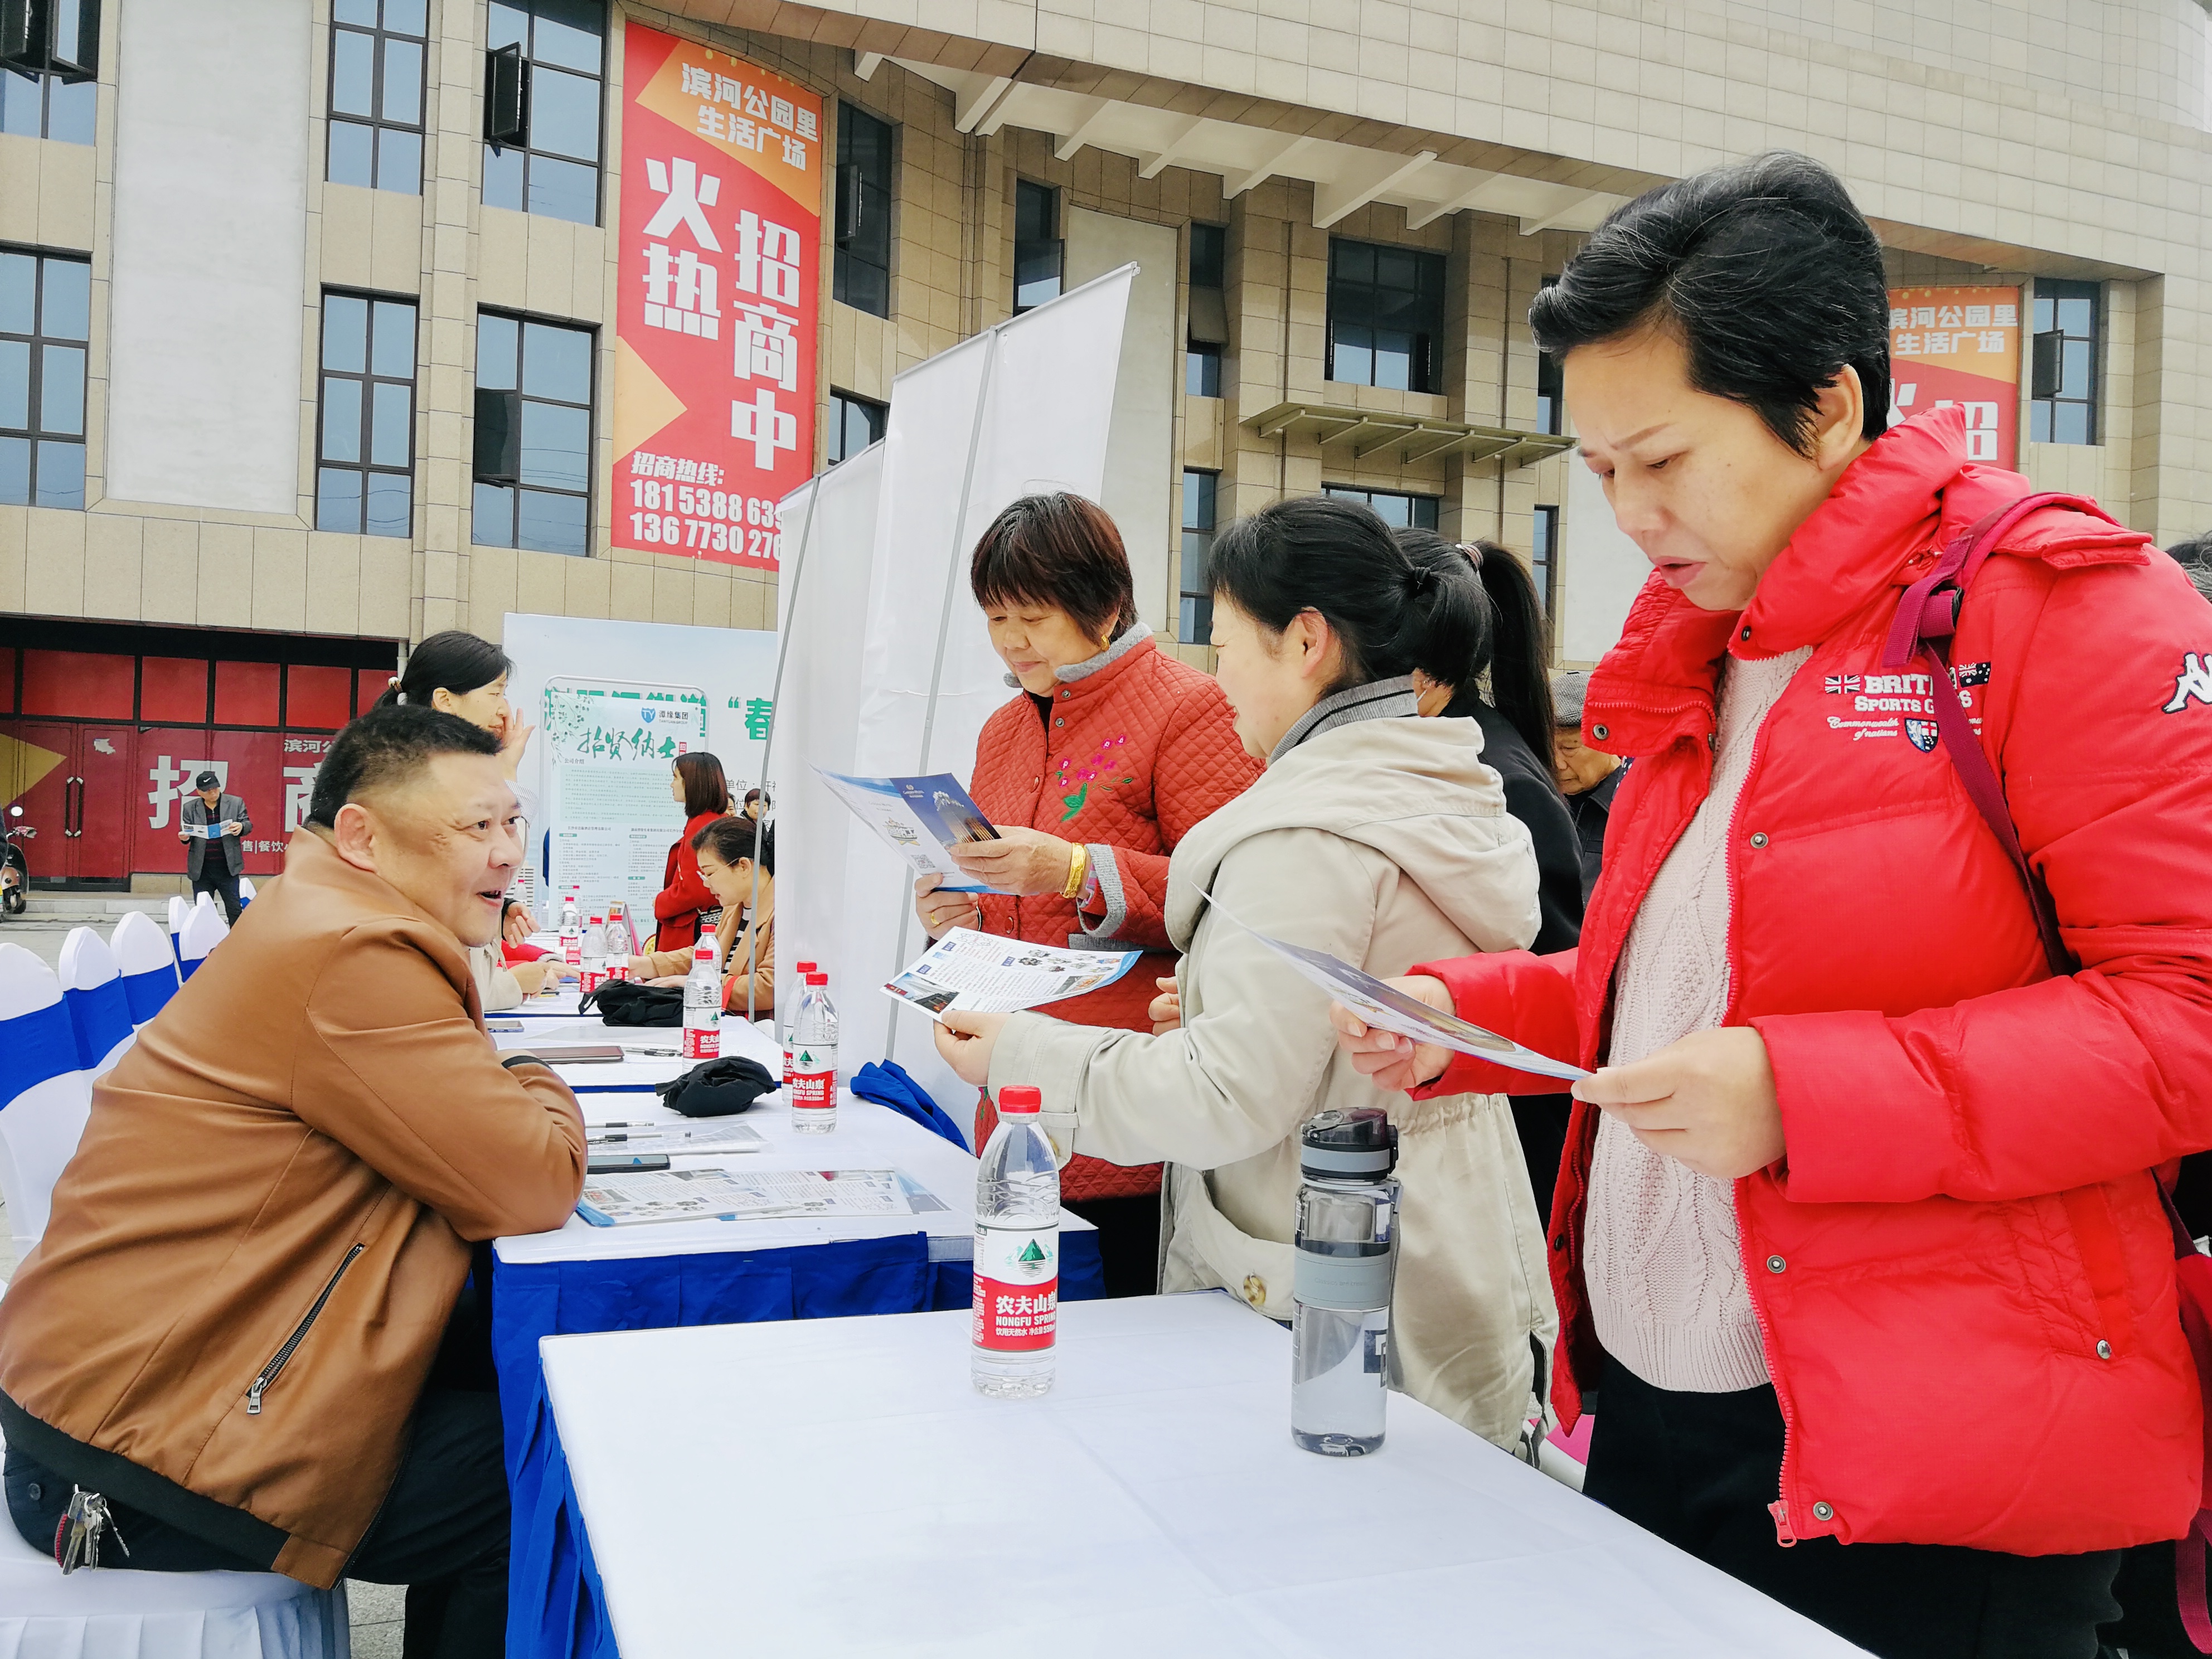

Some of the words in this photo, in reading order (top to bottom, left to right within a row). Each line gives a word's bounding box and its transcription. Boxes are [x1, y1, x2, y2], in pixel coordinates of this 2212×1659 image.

[681, 62, 818, 142] 滨河公园里
[697, 104, 806, 171] 生活广场
[642, 156, 723, 341] 火热
[731, 208, 801, 472] 招商中
[1895, 331, 2005, 356] 生活广场
[629, 450, 725, 487] 招商热线:
[629, 478, 674, 512] 181
[678, 485, 743, 523] 5388
[629, 511, 681, 546] 136
[685, 518, 744, 555] 7730
[576, 725, 677, 761] 招贤纳士
[995, 1291, 1056, 1316] 农夫山泉
[995, 1316, 1032, 1327] NONGFU
[1034, 1311, 1056, 1326] SPRING
[995, 1327, 1028, 1337] 饮用天然水
